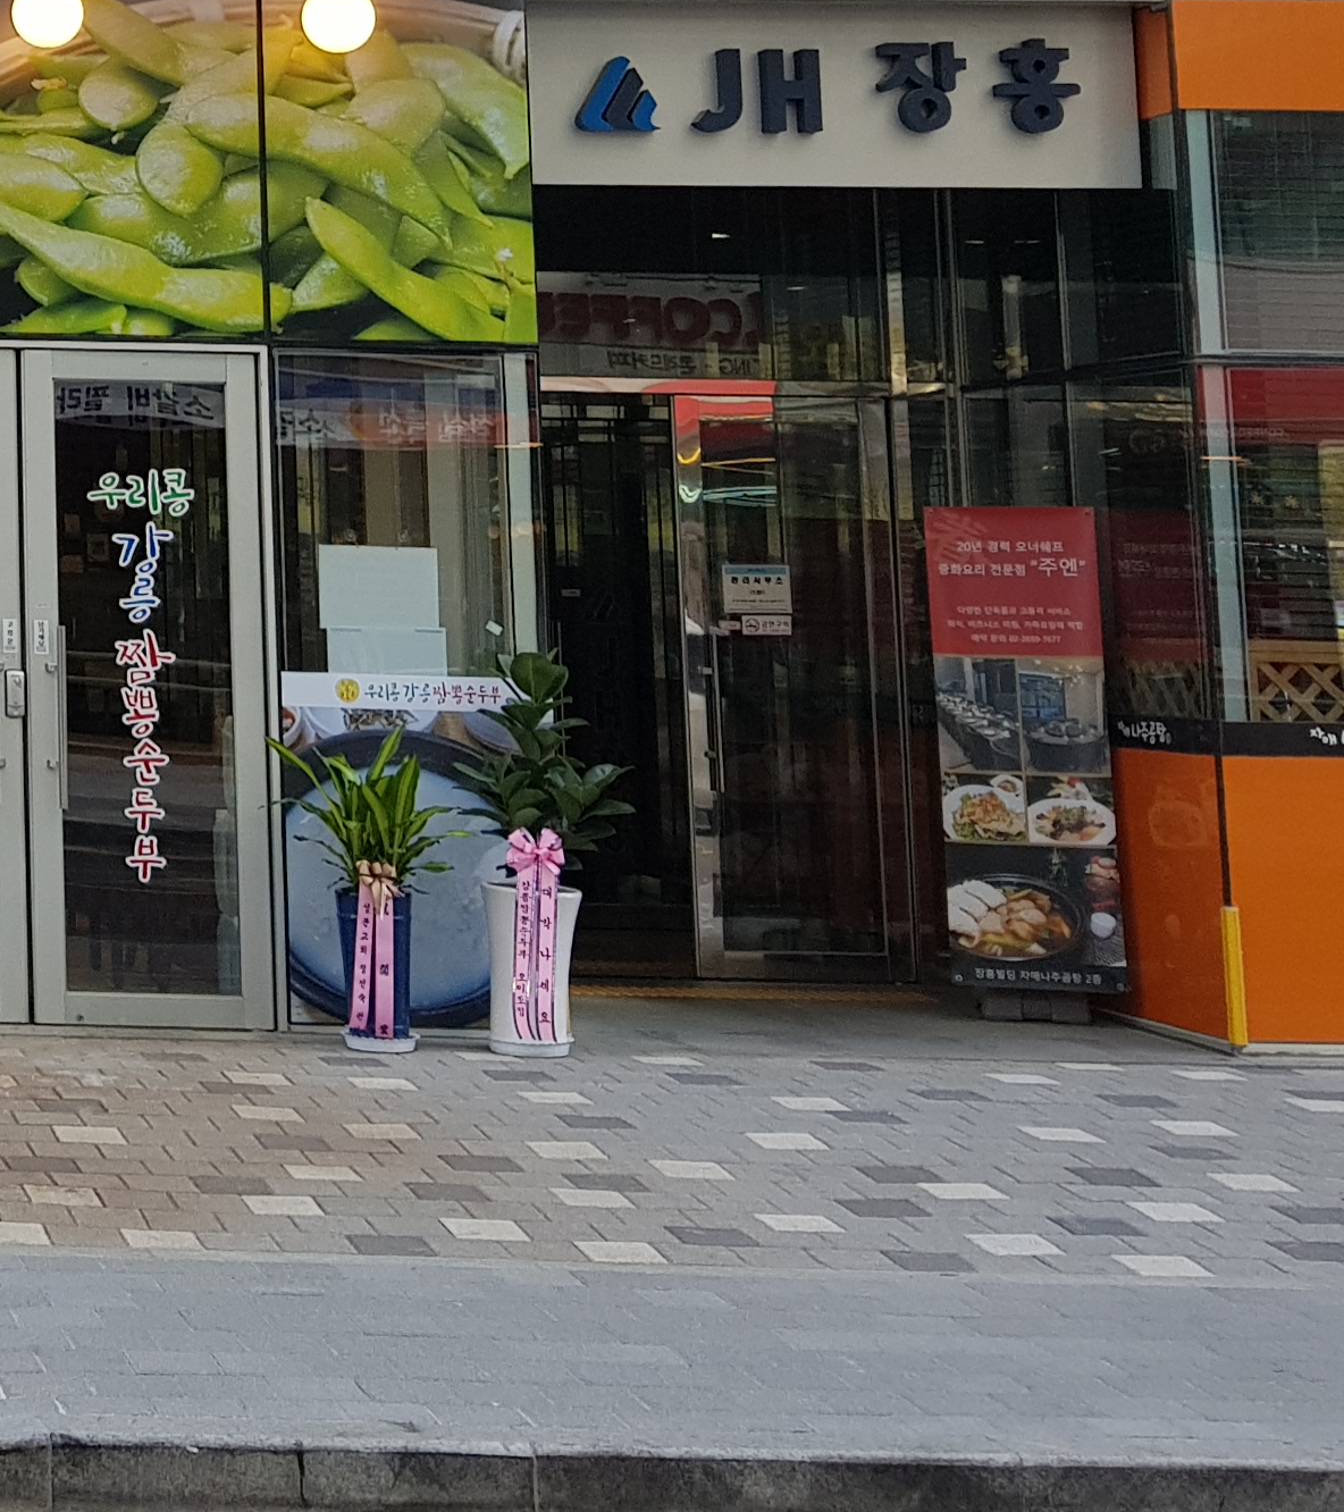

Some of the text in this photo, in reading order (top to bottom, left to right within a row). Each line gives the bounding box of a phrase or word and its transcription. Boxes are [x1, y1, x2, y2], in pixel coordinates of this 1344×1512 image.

[691, 38, 1082, 134] JH 장흥
[87, 468, 195, 518] 우리콩
[112, 522, 174, 623] 강릉
